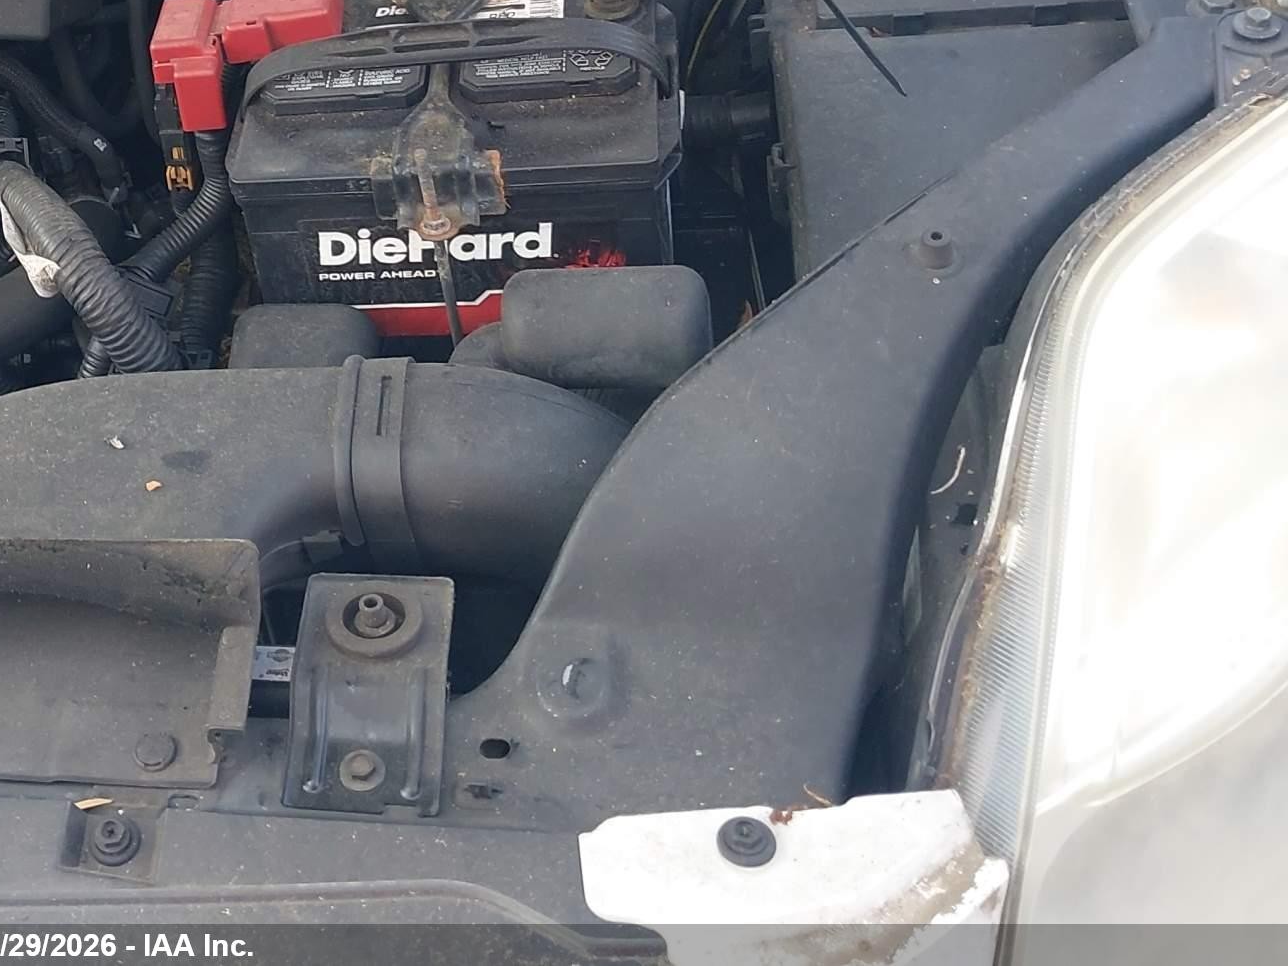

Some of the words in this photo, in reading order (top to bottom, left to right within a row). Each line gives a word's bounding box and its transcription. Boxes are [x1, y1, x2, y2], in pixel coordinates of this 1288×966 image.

[318, 222, 553, 266] DieHard
[318, 271, 375, 281] POWER
[380, 269, 436, 279] AHEAD
